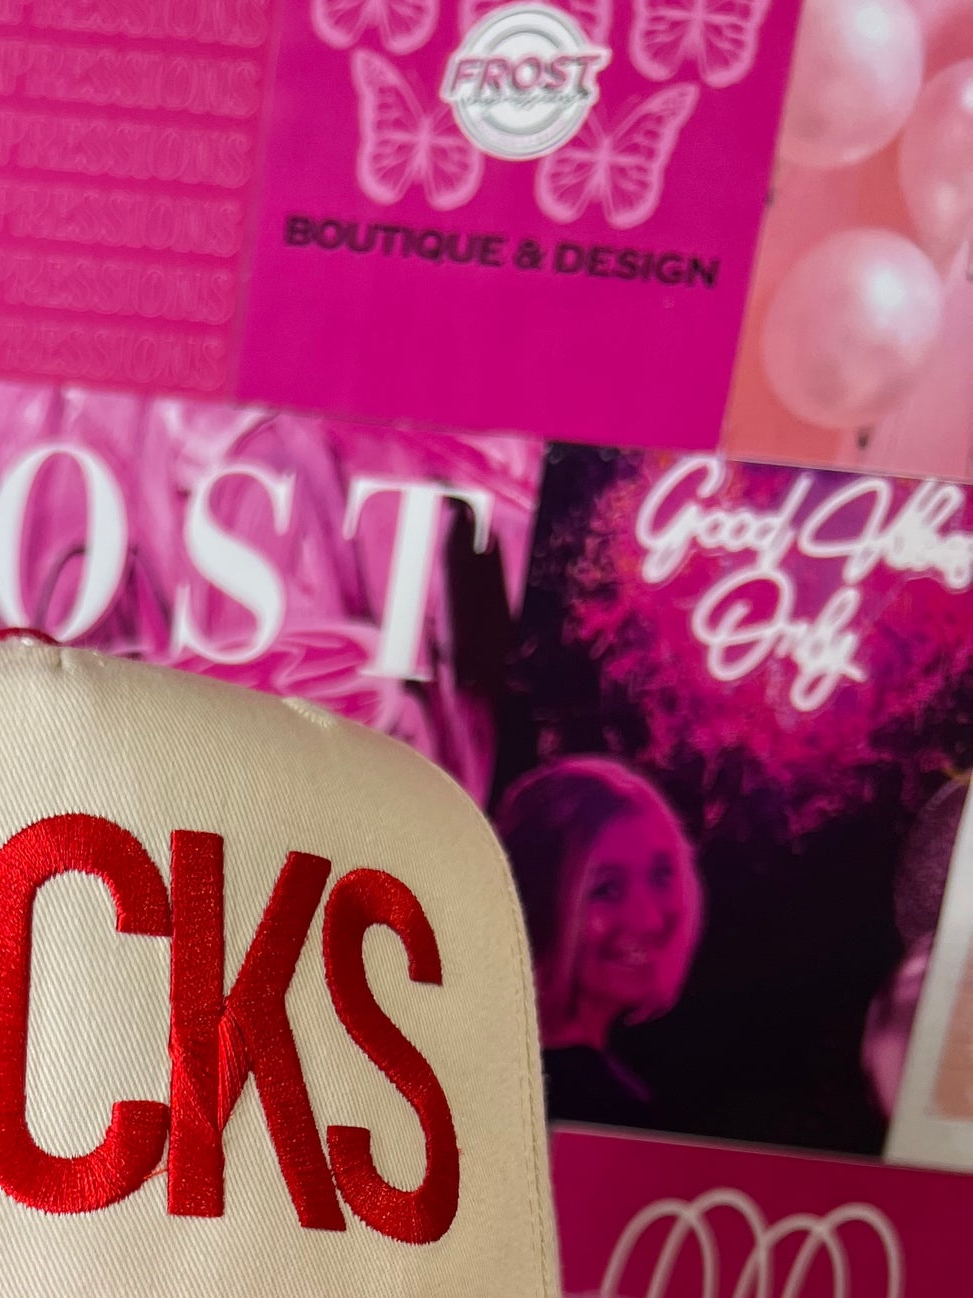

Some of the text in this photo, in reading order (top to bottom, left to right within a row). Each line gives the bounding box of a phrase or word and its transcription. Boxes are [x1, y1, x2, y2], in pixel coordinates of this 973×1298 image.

[449, 54, 604, 97] FROST
[284, 215, 719, 288] BOUTIQUE & DESIGN
[635, 454, 814, 583] Good
